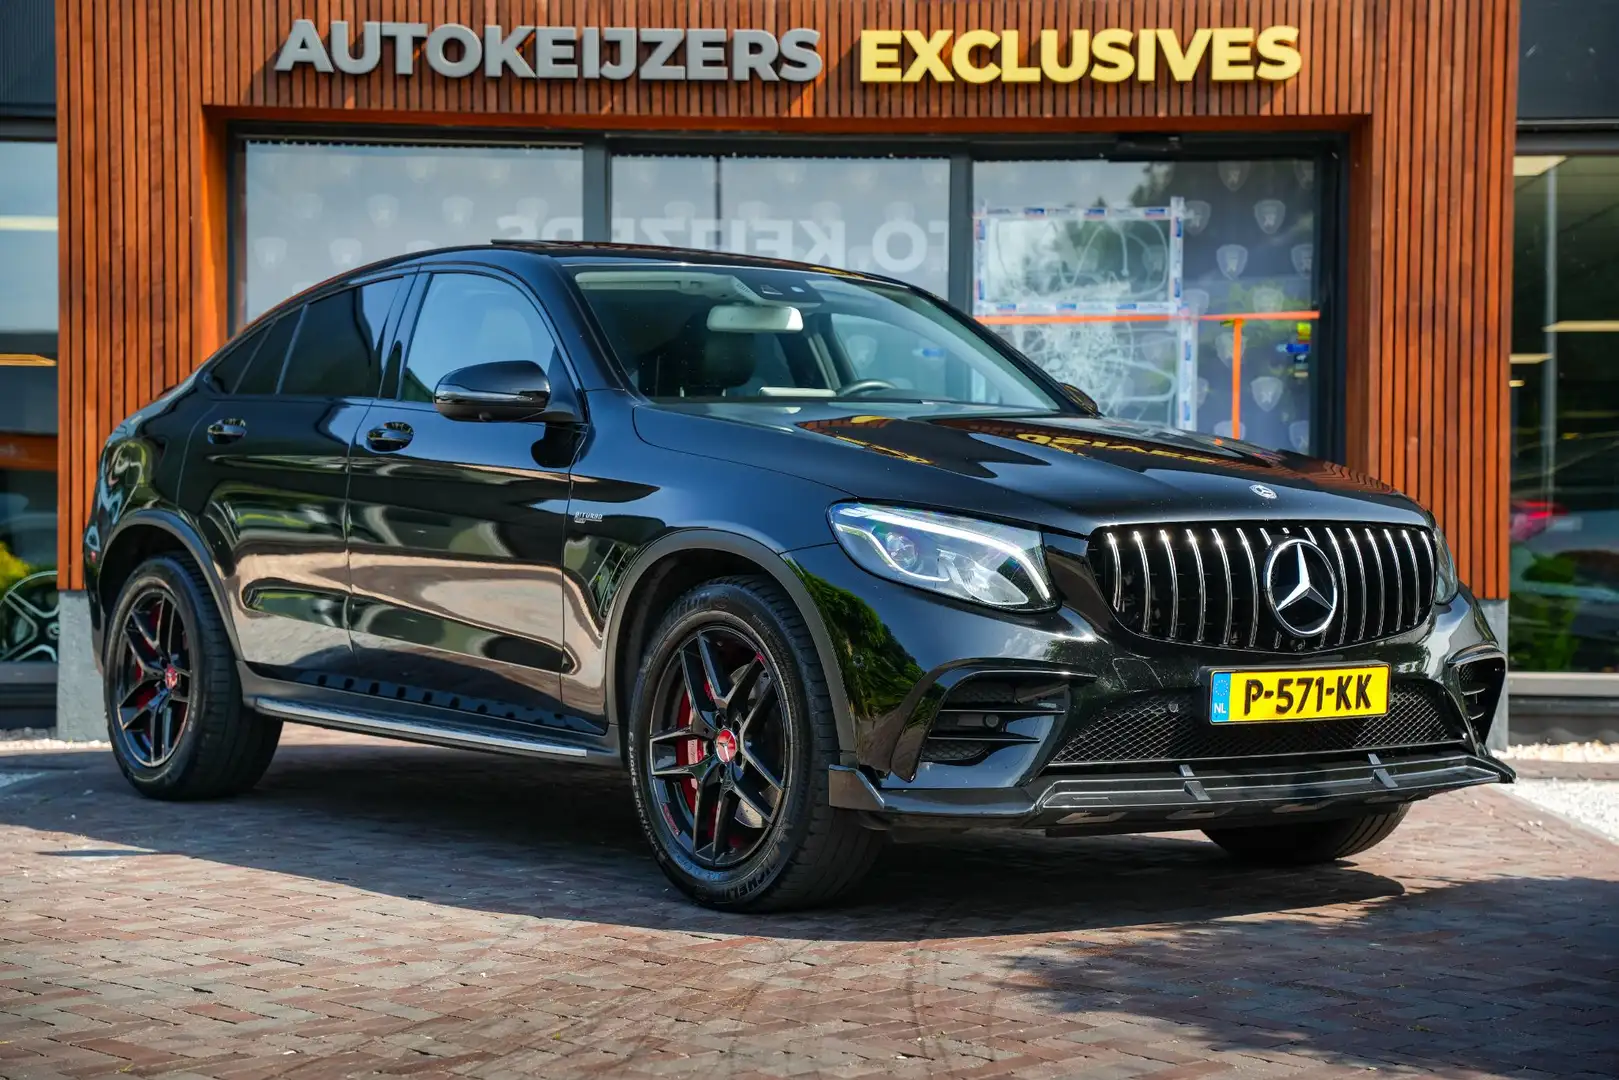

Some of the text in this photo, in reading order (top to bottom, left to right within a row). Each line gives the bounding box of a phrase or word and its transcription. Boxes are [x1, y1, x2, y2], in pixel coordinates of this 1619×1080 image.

[274, 18, 1302, 83] AUTOKEIJZERS EXCLUSIVES
[1214, 703, 1227, 714] NL
[1243, 674, 1372, 716] P-571-KK
